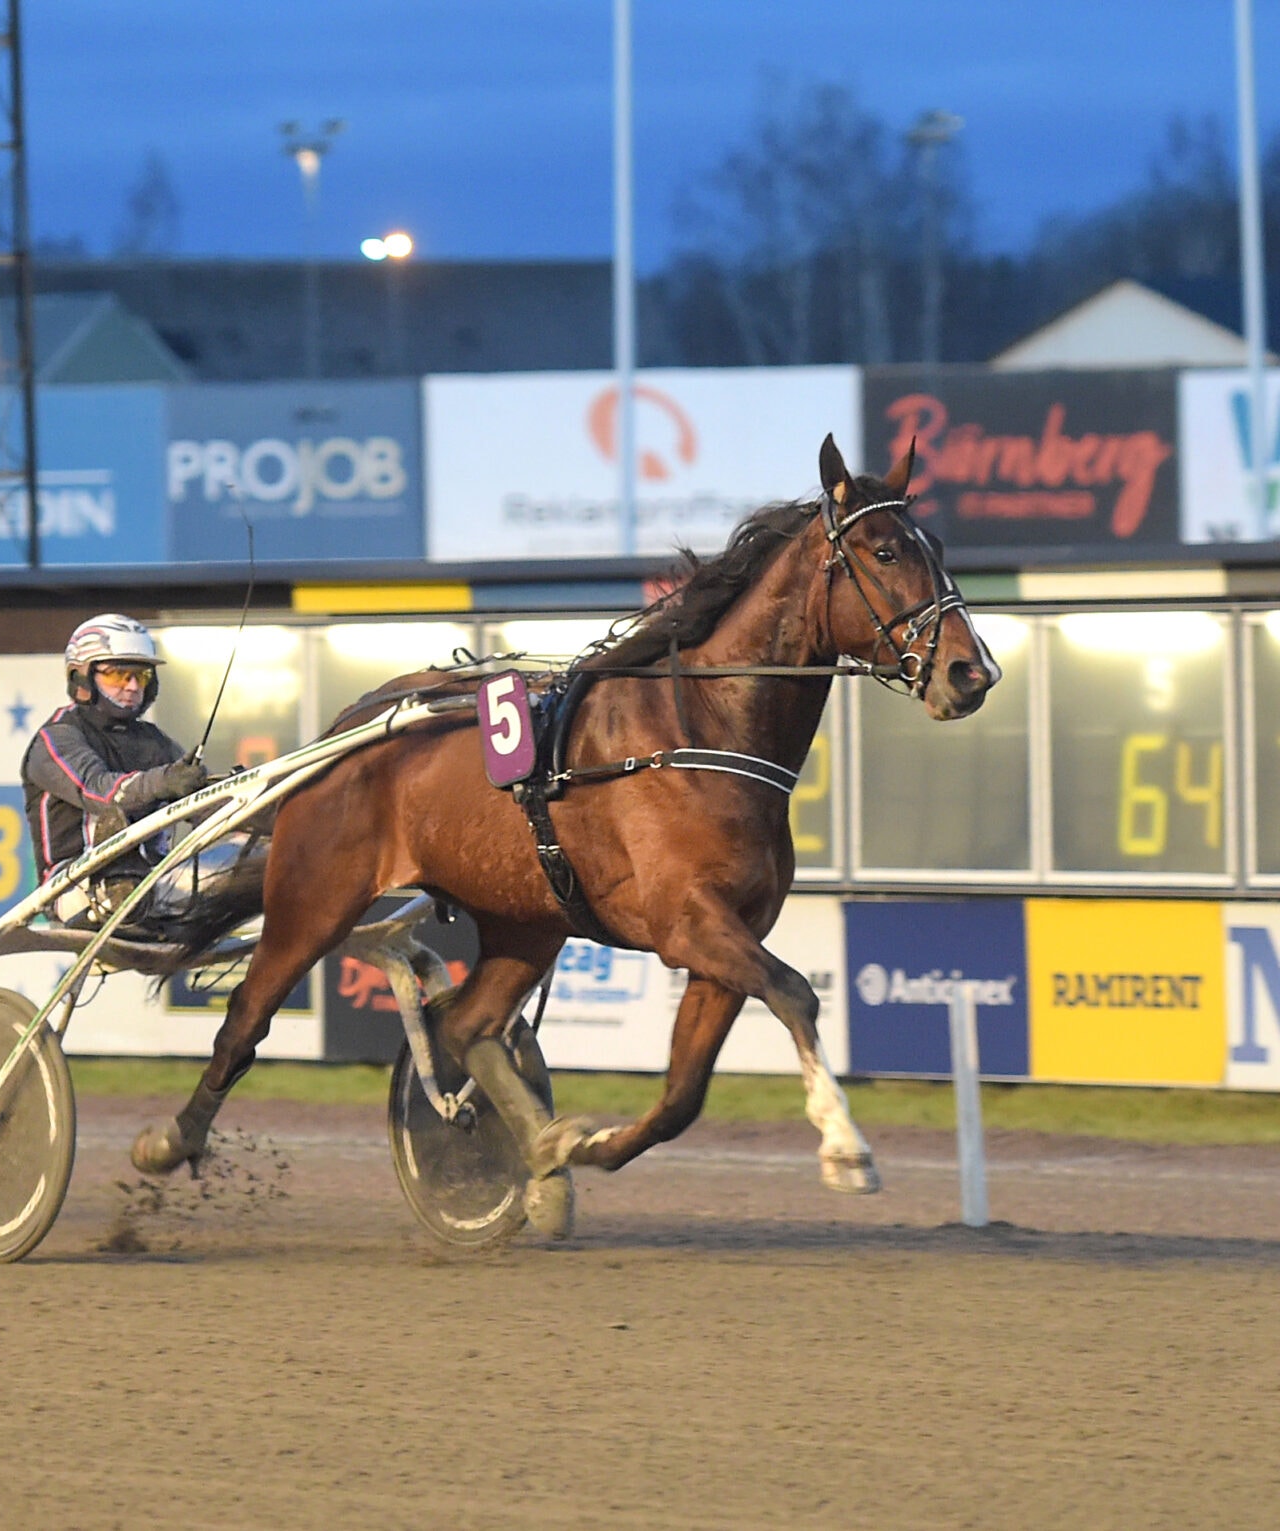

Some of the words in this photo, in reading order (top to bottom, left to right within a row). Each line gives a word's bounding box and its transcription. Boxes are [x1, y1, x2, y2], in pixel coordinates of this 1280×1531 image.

[168, 437, 406, 517] PROJOB
[486, 675, 522, 755] 5
[1120, 734, 1224, 856] 64
[1052, 973, 1202, 1009] RAMIRENT
